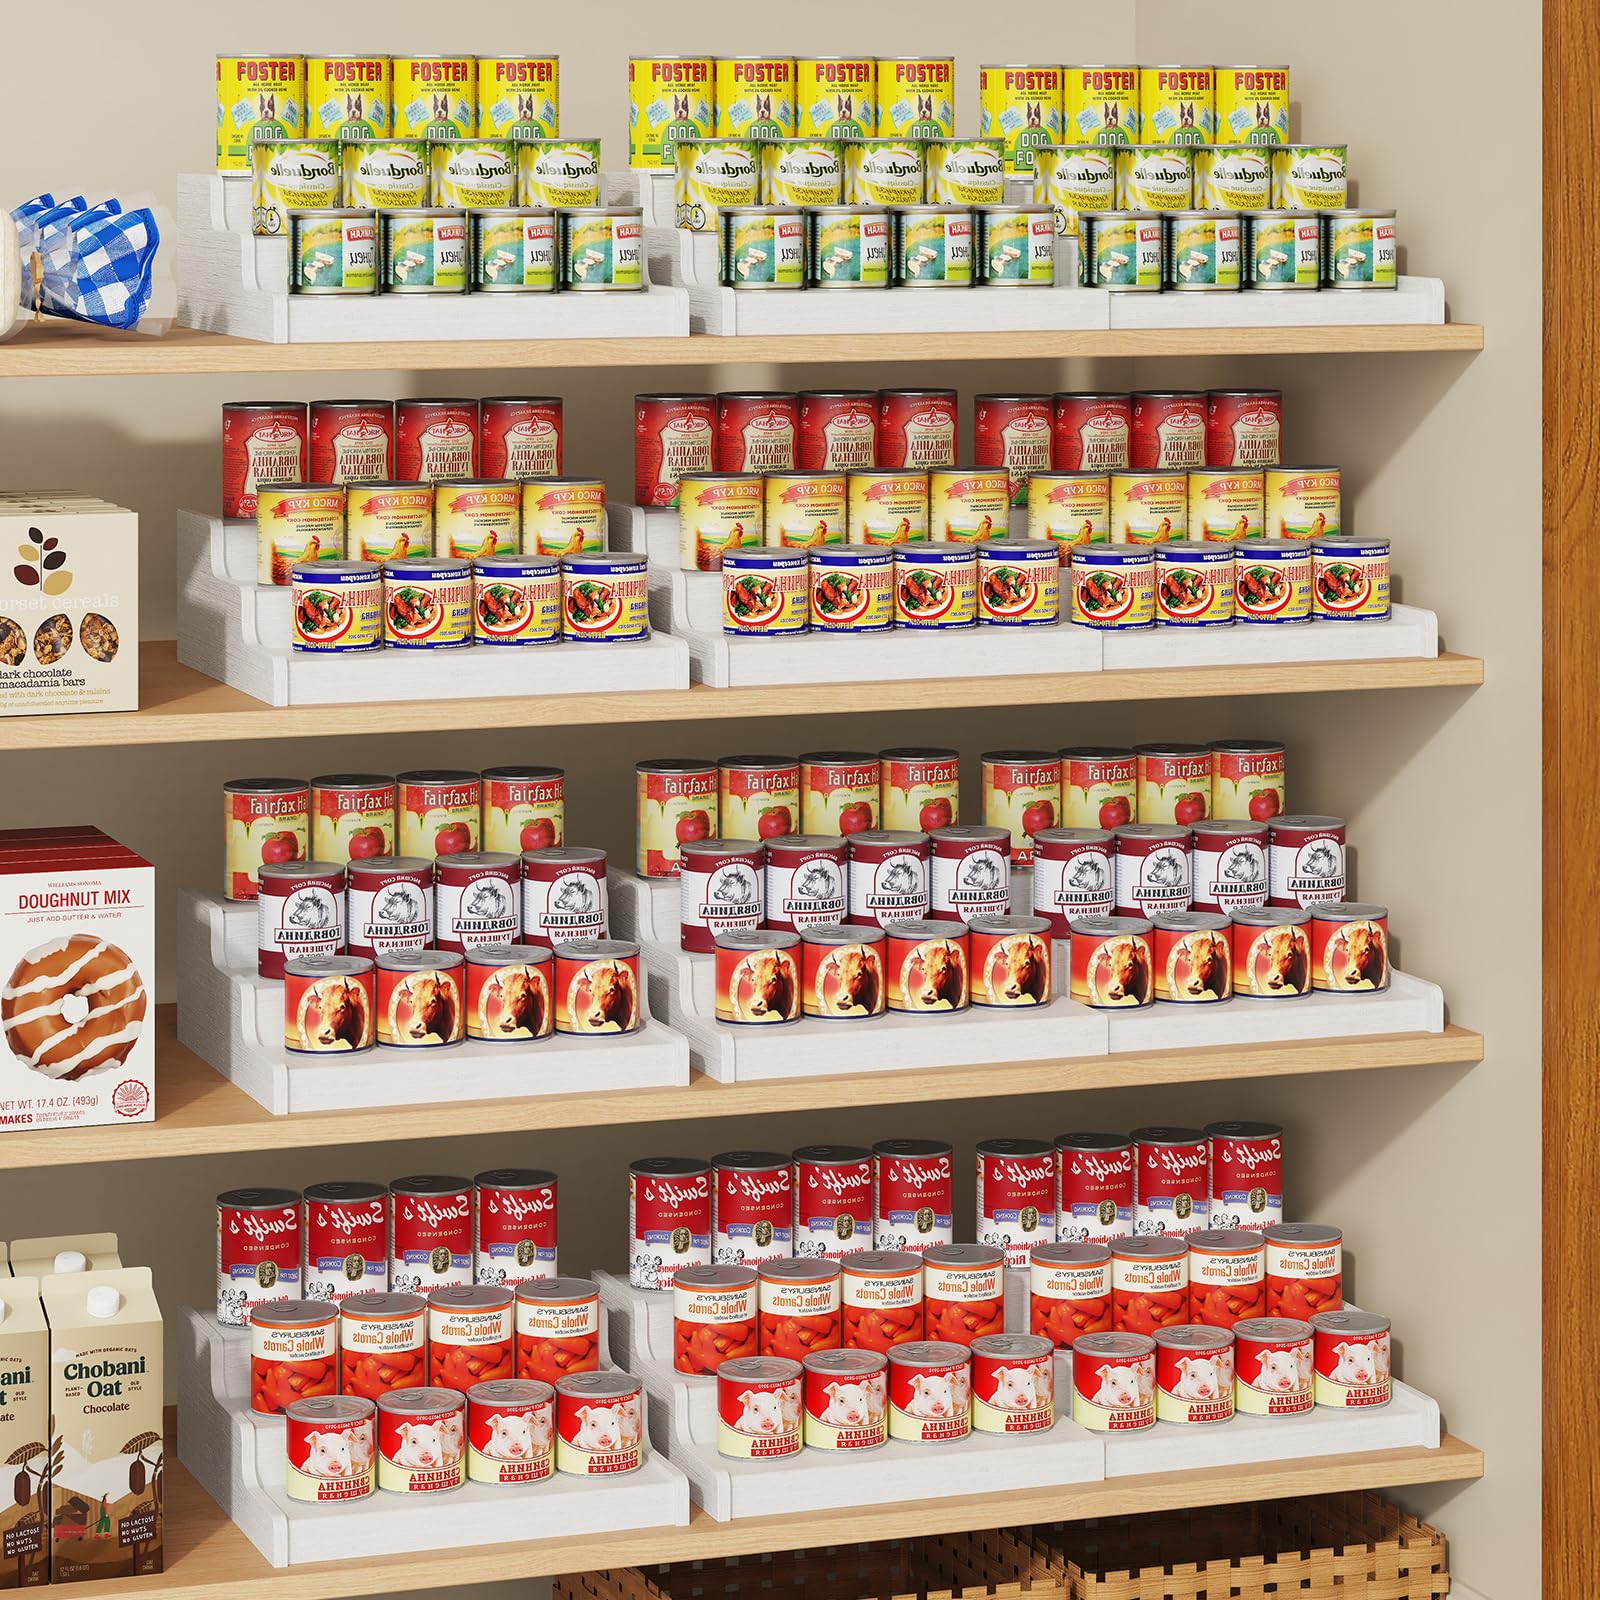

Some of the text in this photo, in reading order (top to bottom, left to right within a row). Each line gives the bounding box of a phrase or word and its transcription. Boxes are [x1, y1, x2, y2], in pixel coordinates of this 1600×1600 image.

[237, 62, 295, 81] FOSTER
[324, 62, 382, 81] FOSTER
[411, 62, 468, 81] FOSTER
[496, 62, 552, 81] FOSTER
[652, 64, 707, 82] FOSTER
[734, 64, 789, 82] FOSTER
[816, 64, 870, 82] FOSTER
[896, 64, 949, 82] FOSTER
[1005, 72, 1058, 90] FOSTER
[1082, 72, 1135, 90] FOSTER
[1158, 72, 1210, 90] FOSTER
[1234, 72, 1286, 90] FOSTER
[254, 126, 282, 138] DOG
[341, 126, 369, 138] DOG
[512, 126, 540, 138] DOG
[668, 126, 696, 138] DOG
[832, 126, 858, 138] DOG
[912, 126, 939, 138] DOG
[1021, 132, 1048, 146] DOG
[1250, 132, 1276, 144] DOG
[23, 668, 73, 678] chocolate
[62, 677, 86, 686] bars
[1088, 764, 1129, 780] Fairfax
[1164, 760, 1204, 776] Fairfax
[1238, 757, 1279, 773] Fairfax
[747, 772, 789, 790] Fairfax
[828, 769, 871, 786] Fairfax
[909, 766, 950, 782] Fairfax
[1011, 767, 1053, 785] Fairfax
[665, 775, 708, 794] Fairfax
[423, 789, 469, 806] Fairfax
[509, 785, 554, 801] Fairfax
[250, 797, 295, 815] Fairfax
[338, 793, 382, 810] Fairfax
[19, 889, 130, 909] DOUGHNUT MIX
[37, 1098, 54, 1108] 17.4
[73, 1095, 99, 1107] (493g)
[0, 1114, 33, 1125] MAKES
[64, 1356, 146, 1380] Chobani
[87, 1380, 122, 1398] Oat
[83, 1402, 130, 1414] Chocolate
[131, 1516, 154, 1526] LACTOSE
[17, 1527, 40, 1538] LACTOSE
[131, 1526, 147, 1534] NUTS
[132, 1532, 153, 1541] GLUTEN
[17, 1544, 39, 1552] GLUTEN
